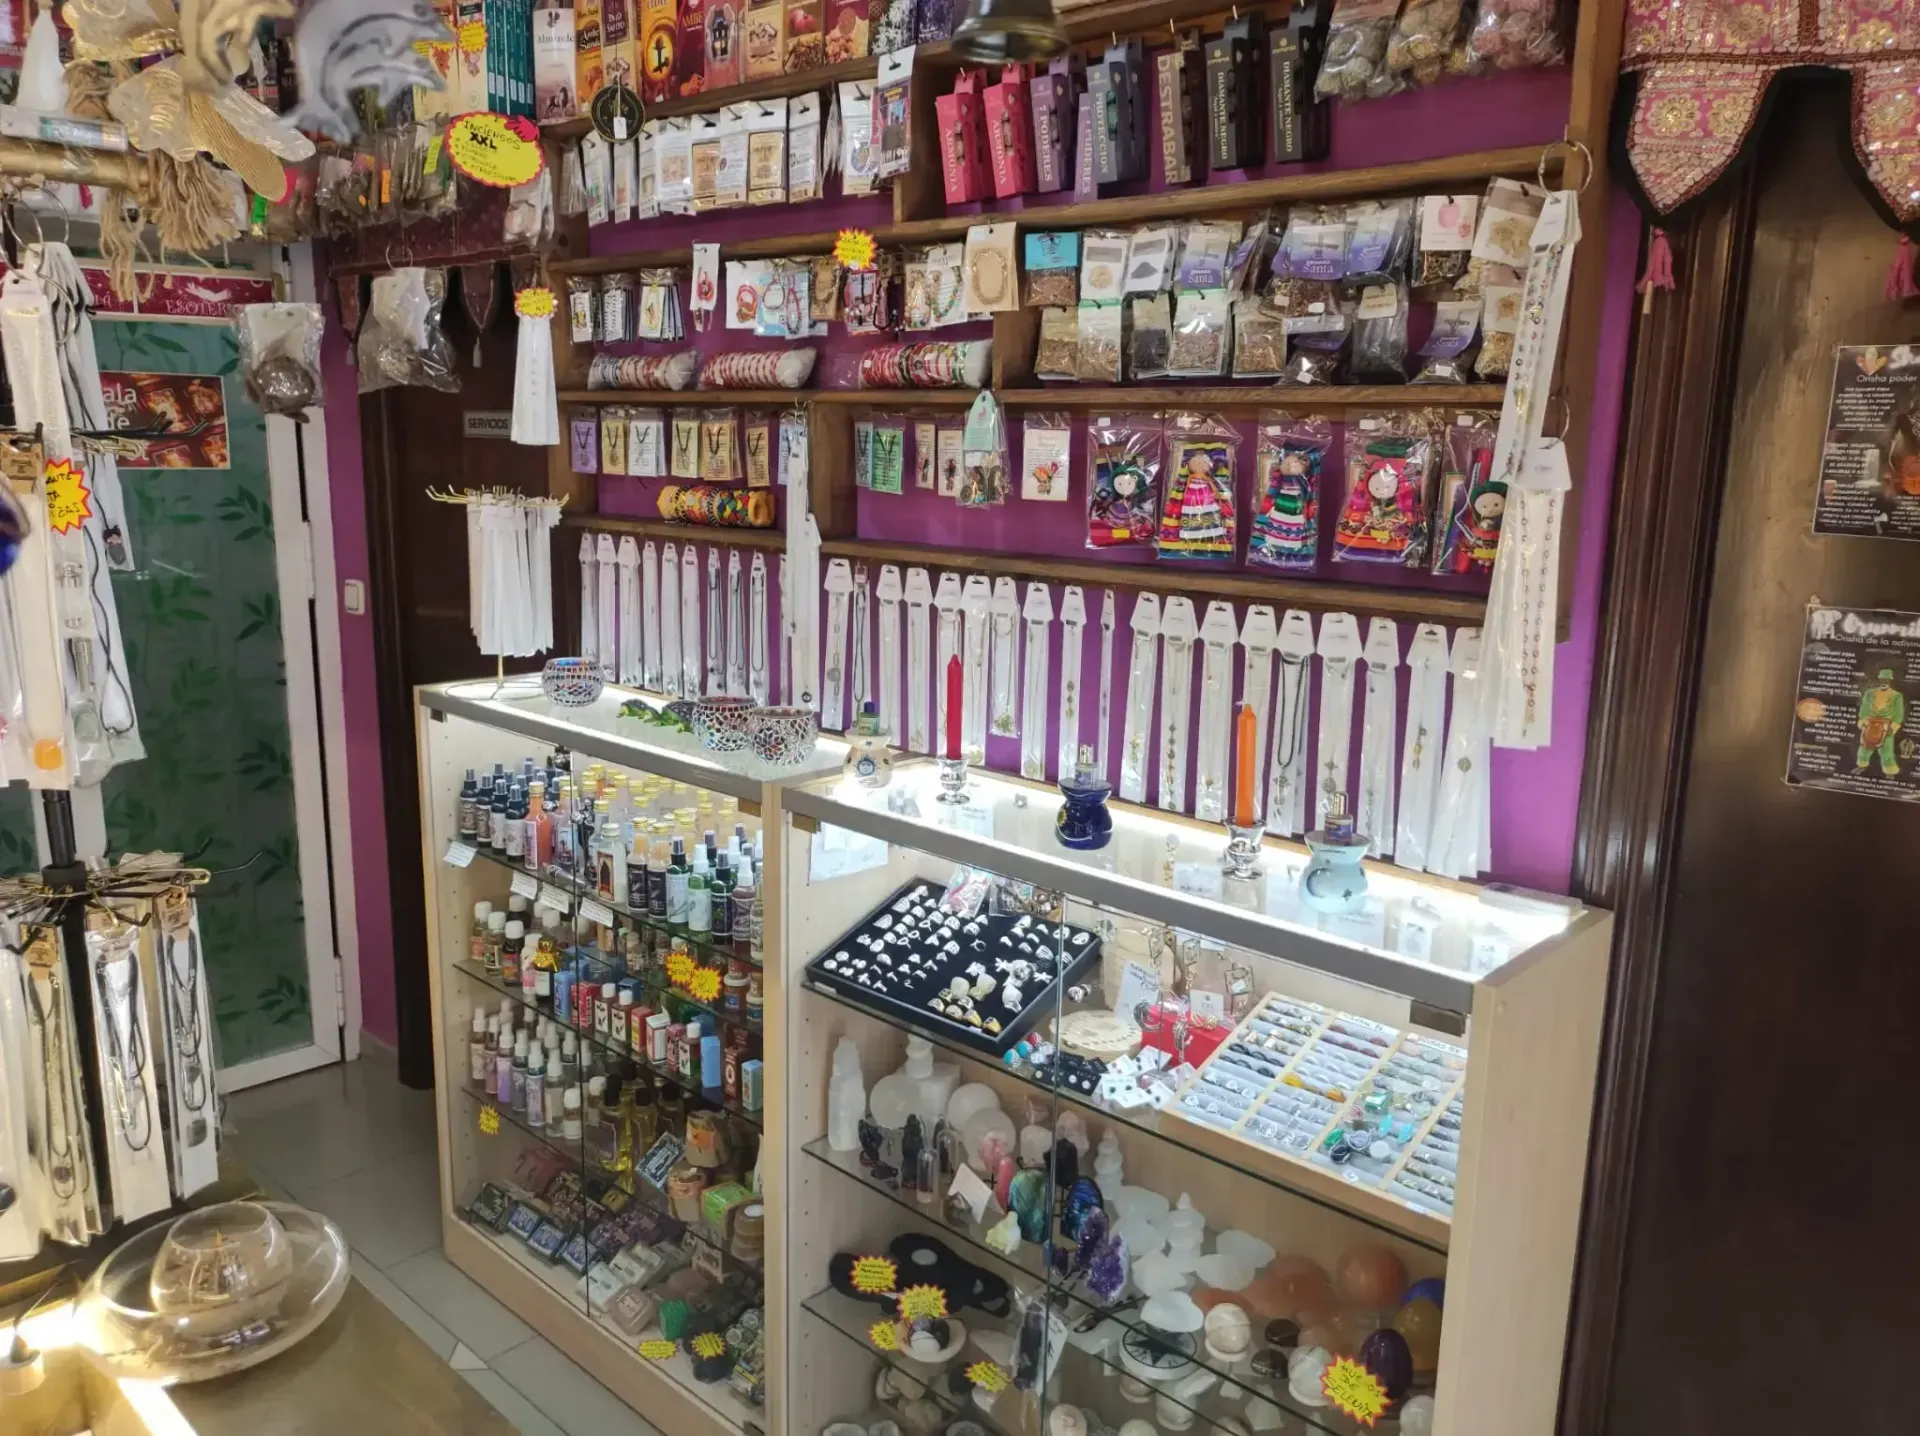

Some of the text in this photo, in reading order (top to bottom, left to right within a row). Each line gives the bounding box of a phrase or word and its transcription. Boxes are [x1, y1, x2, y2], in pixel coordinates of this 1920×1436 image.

[1217, 72, 1226, 123] DIAMANTE
[1282, 61, 1293, 153] DIAMANTE NEGRO
[1157, 55, 1178, 184] DESTRABAR
[469, 131, 497, 150] XXL
[1039, 114, 1053, 182] PODERES
[1219, 124, 1228, 160] NEGRO
[1187, 274, 1214, 284] Santa
[1303, 264, 1334, 274] Santa
[1856, 373, 1918, 384] Orisha poder
[467, 417, 509, 429] SERVICIOS
[1835, 634, 1864, 644] Orisha
[1866, 636, 1878, 644] de
[1880, 638, 1890, 646] la
[1340, 1364, 1381, 1398] HUEOS
